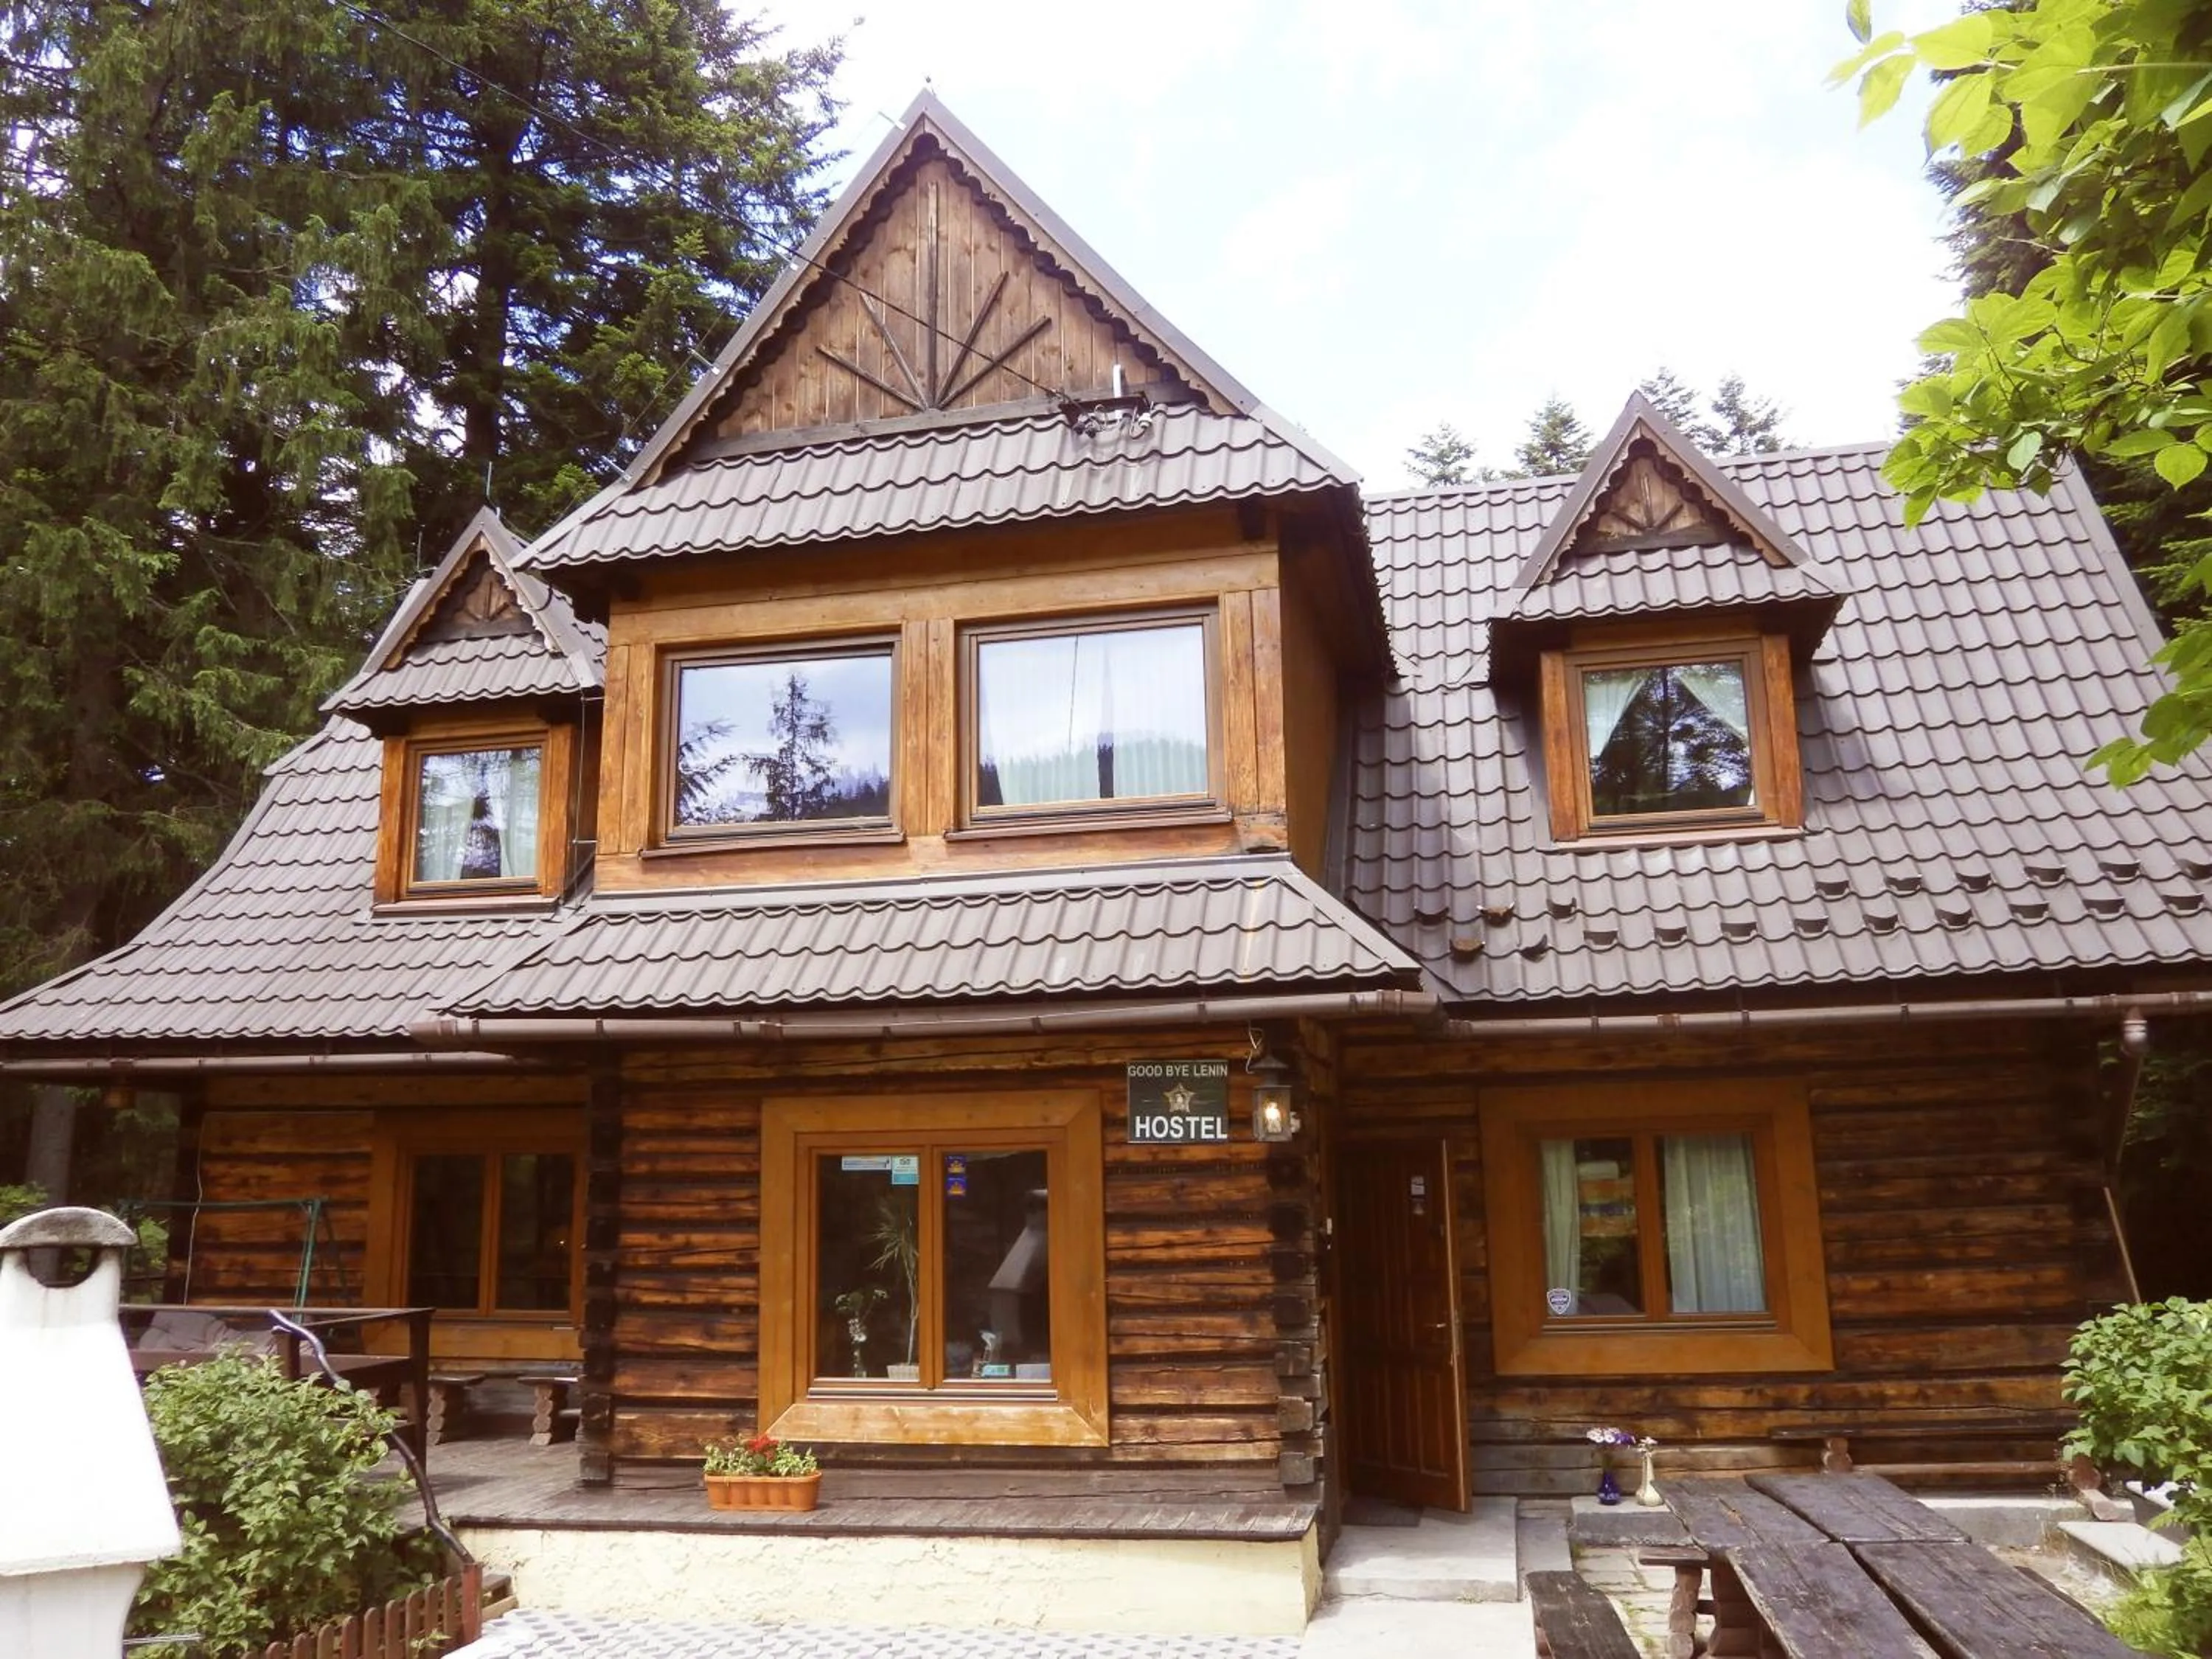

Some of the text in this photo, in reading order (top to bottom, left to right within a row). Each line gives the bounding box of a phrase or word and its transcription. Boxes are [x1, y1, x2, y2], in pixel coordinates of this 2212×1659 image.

[1127, 1065, 1228, 1077] GOOD BYE LENIN
[1135, 1116, 1228, 1139] HOSTEL
